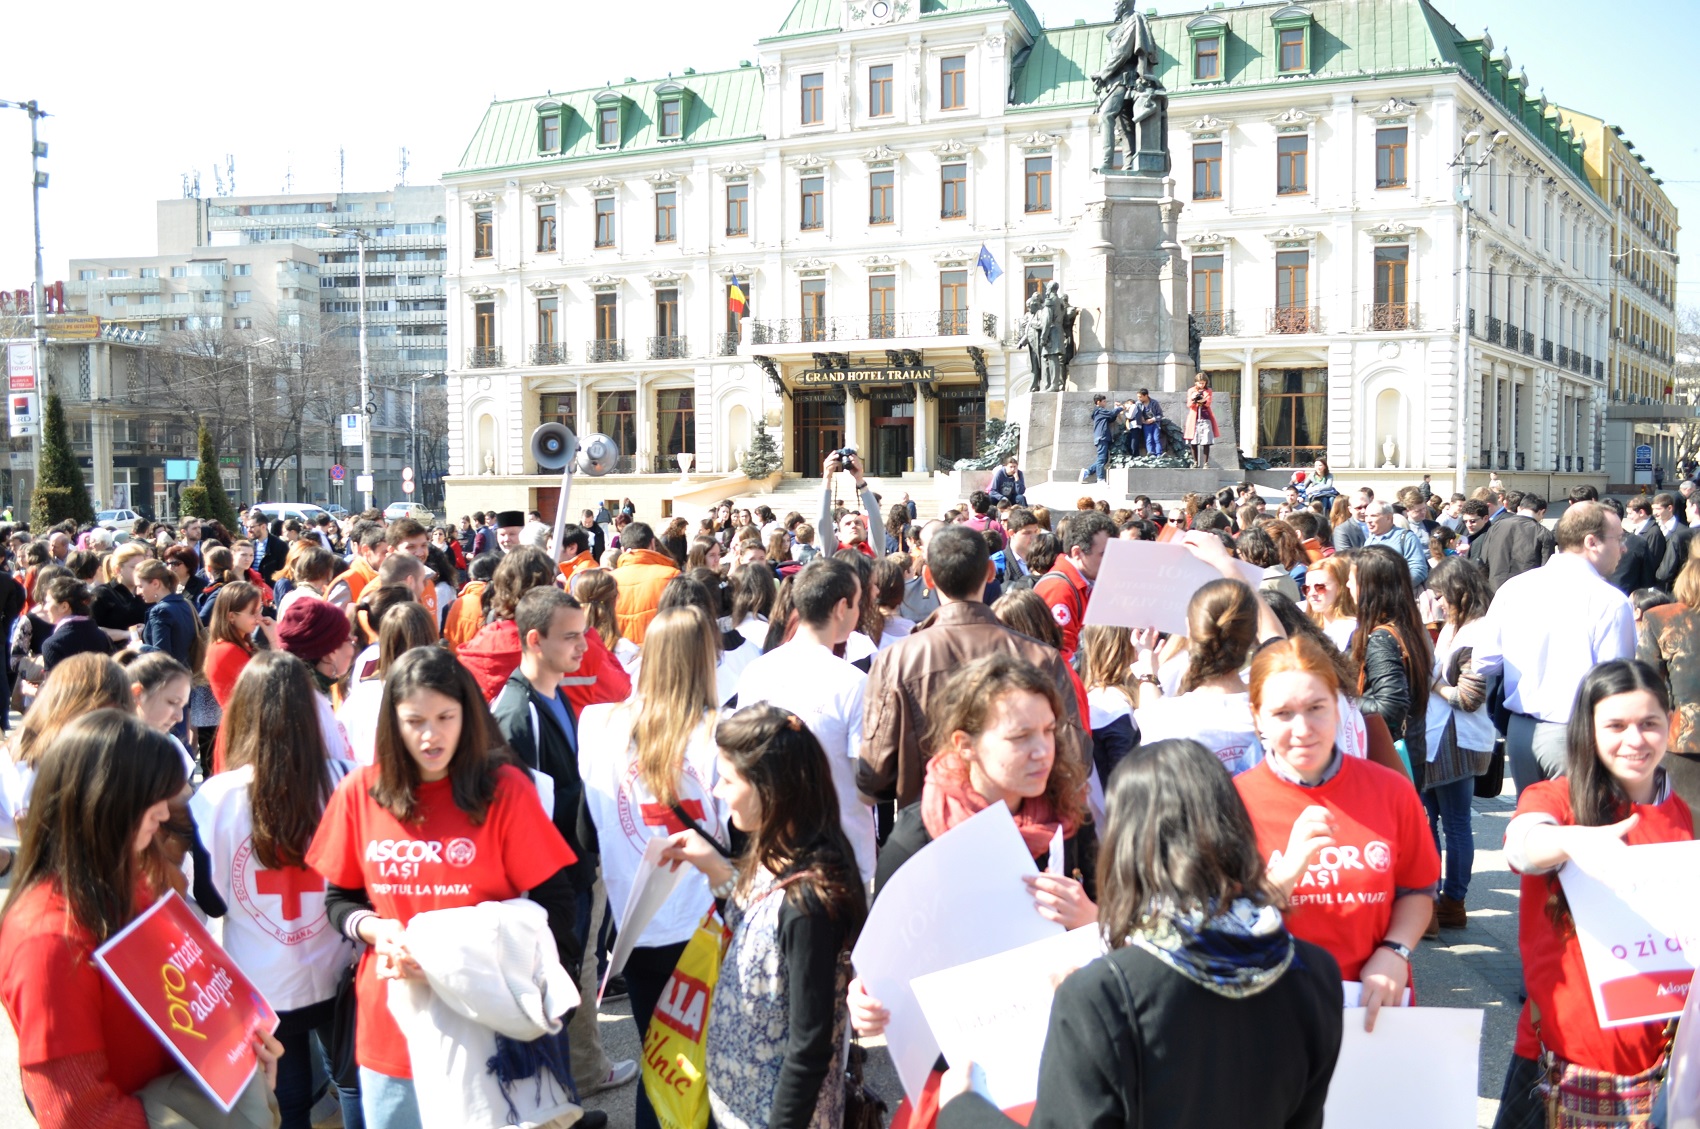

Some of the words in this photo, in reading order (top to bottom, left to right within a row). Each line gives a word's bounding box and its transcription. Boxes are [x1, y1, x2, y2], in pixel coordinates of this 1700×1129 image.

[806, 371, 845, 382] GRAND
[847, 370, 885, 381] HOTEL
[887, 369, 932, 380] TRAIAN
[795, 394, 841, 403] RESTAURAN
[942, 389, 983, 398] HOTEL
[1215, 748, 1245, 761] ONALA
[365, 839, 443, 863] ASCOR
[233, 846, 250, 902] SOCIETATEA
[1293, 869, 1339, 888] AȘI
[415, 884, 432, 896] LA
[1289, 892, 1334, 906] EPTUL
[1337, 892, 1355, 904] LA
[274, 927, 314, 944] ROMANA
[1611, 944, 1628, 960] o
[1634, 933, 1658, 958] zi
[160, 963, 208, 1040] pro
